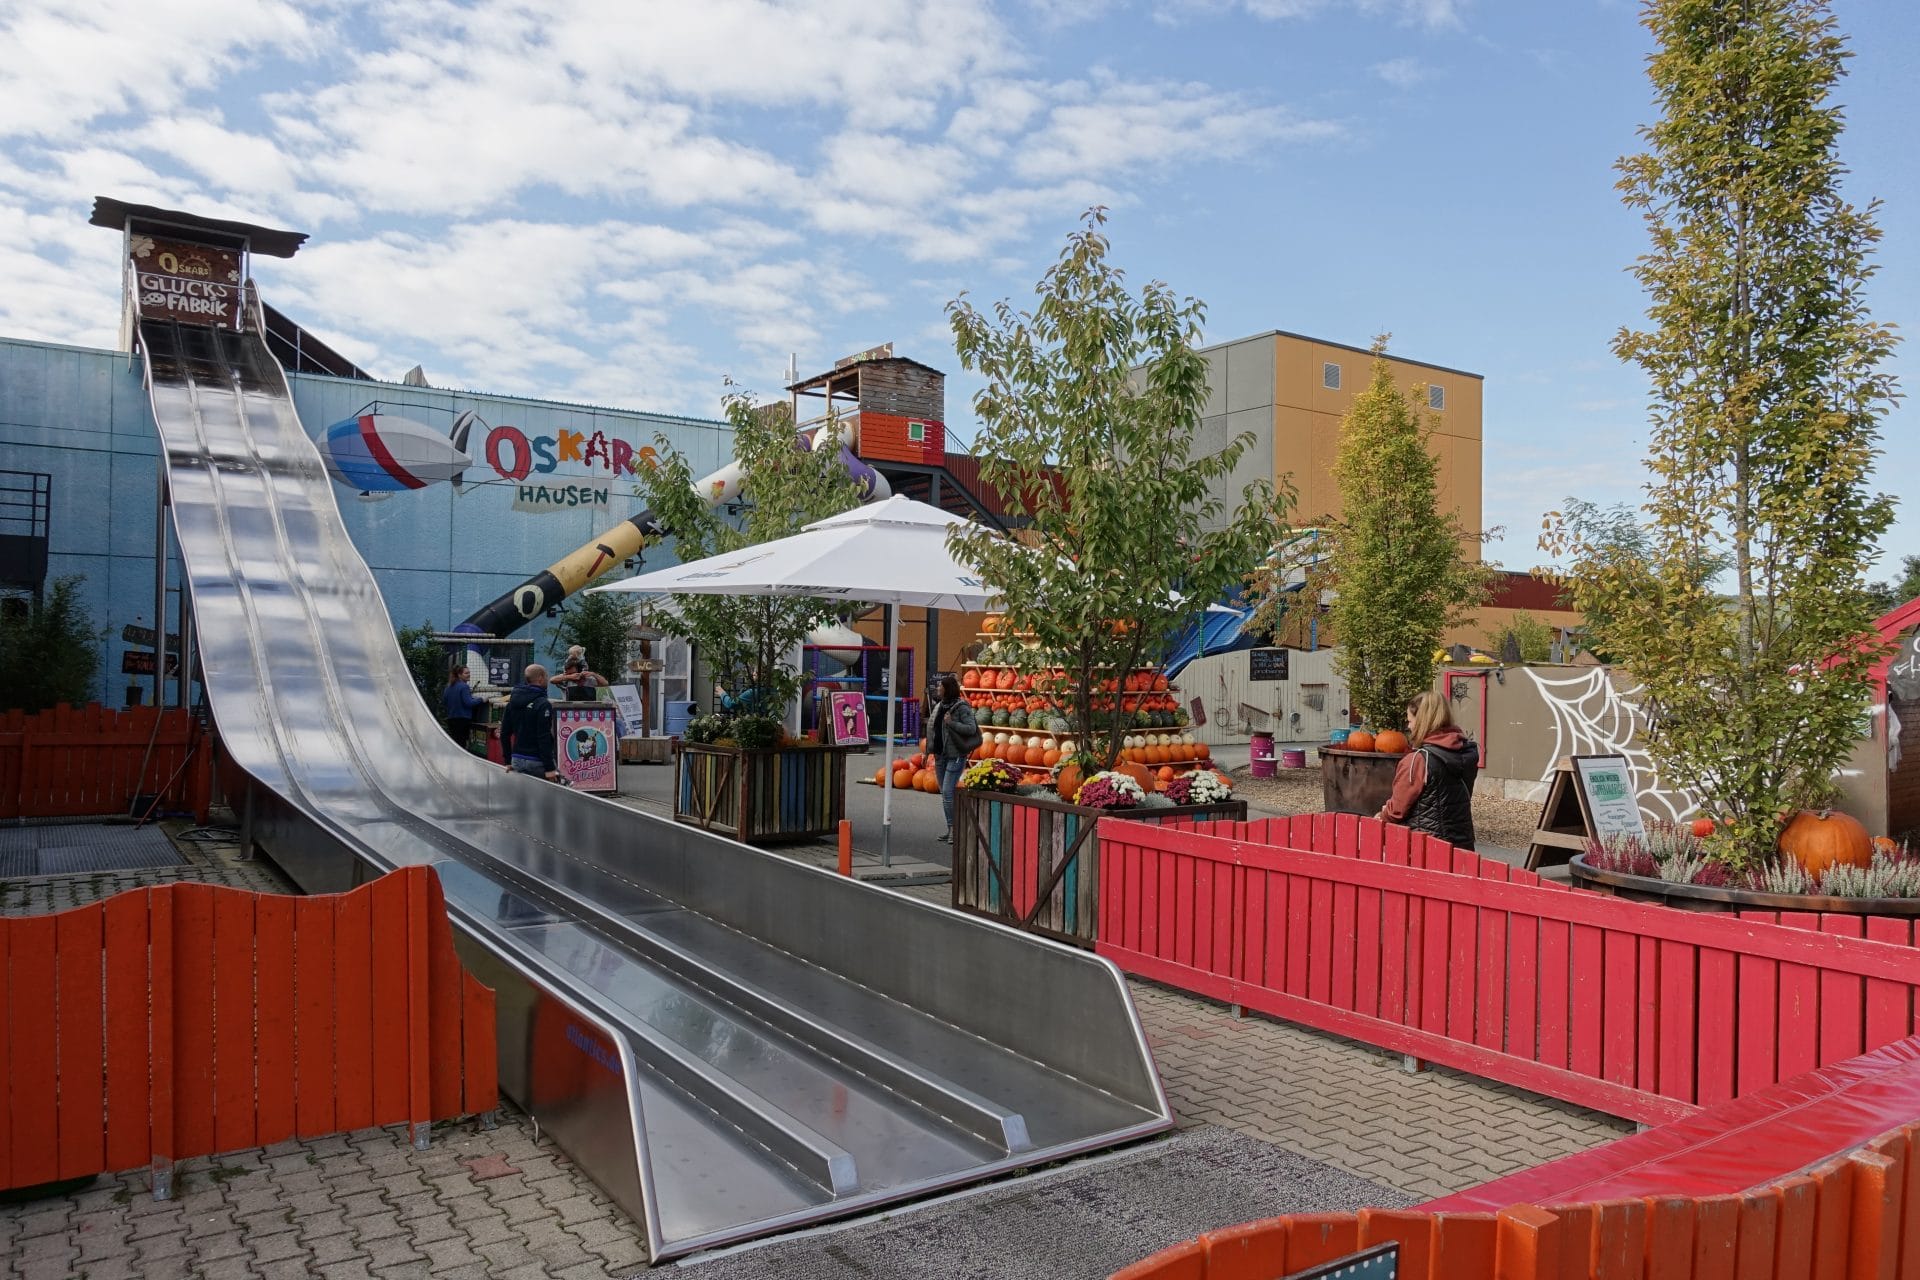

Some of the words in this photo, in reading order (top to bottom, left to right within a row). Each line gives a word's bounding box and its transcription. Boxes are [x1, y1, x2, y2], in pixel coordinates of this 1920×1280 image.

[485, 425, 657, 482] OSKARS
[519, 485, 608, 507] HAUSEN
[637, 661, 653, 670] WC
